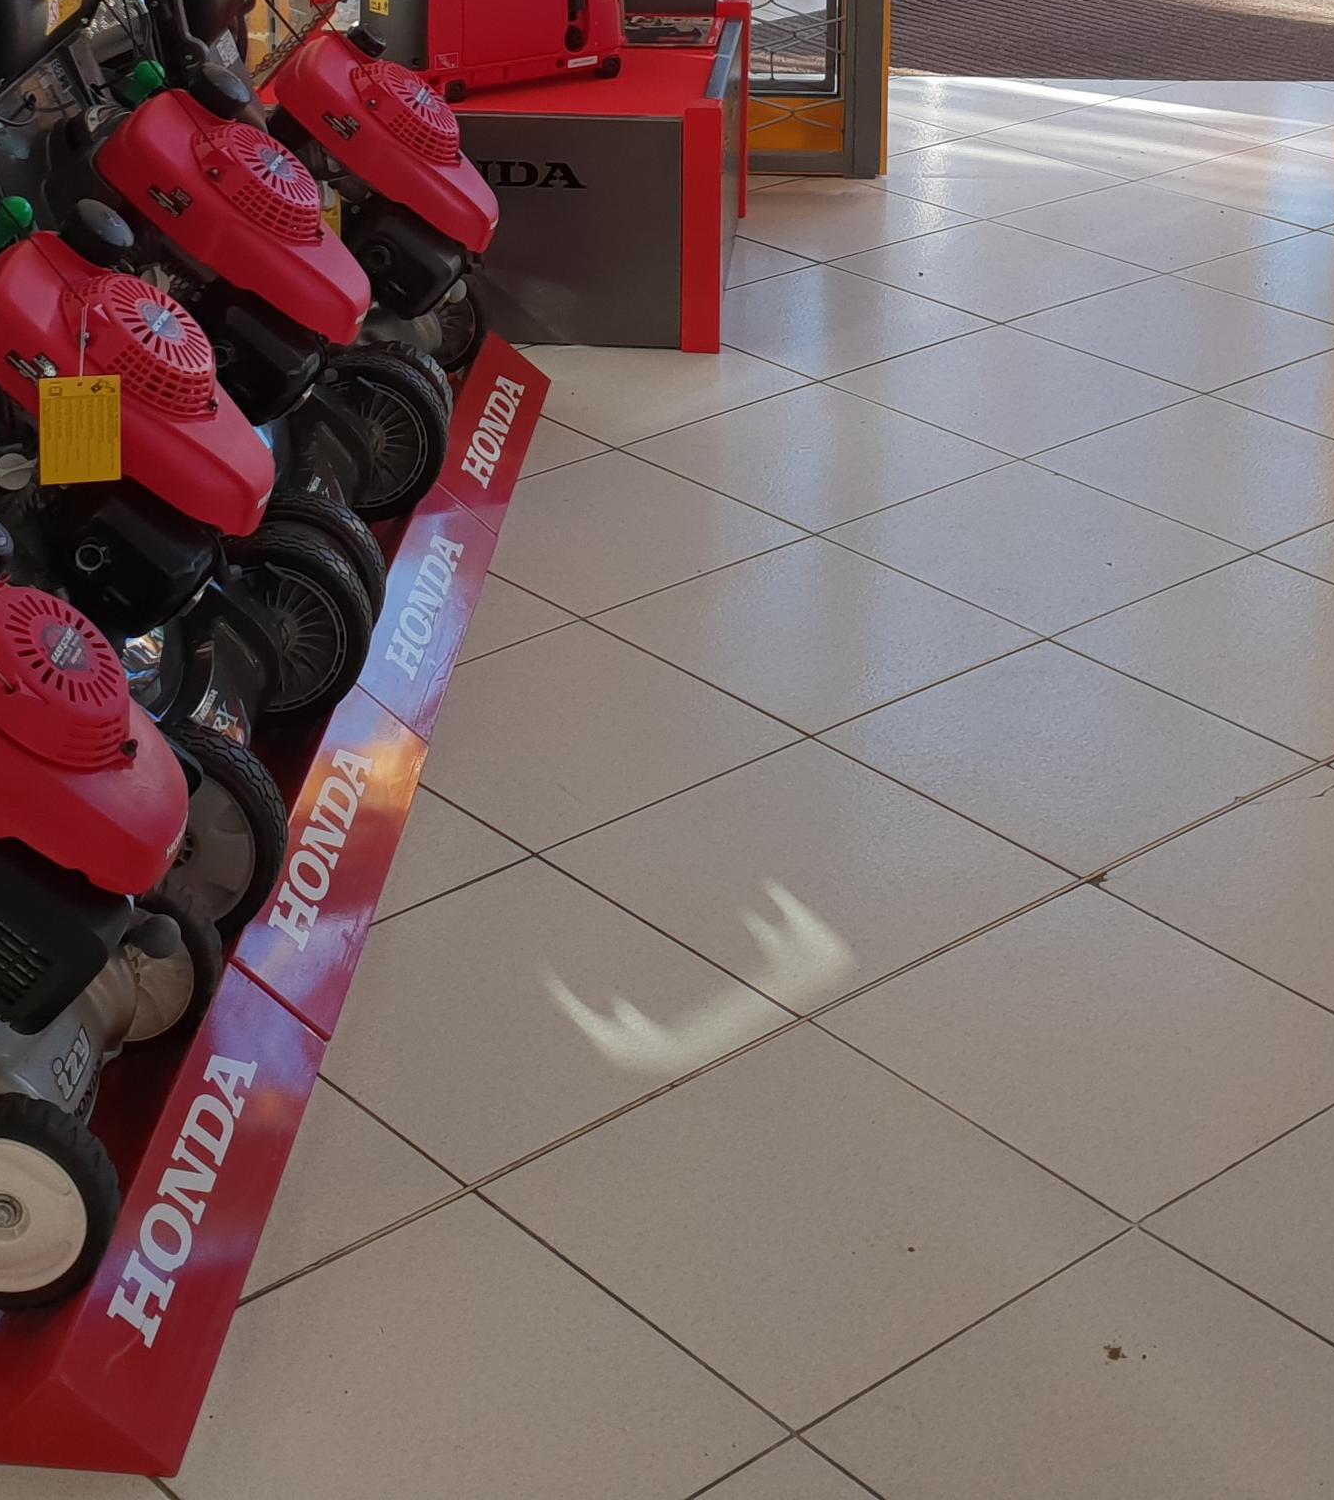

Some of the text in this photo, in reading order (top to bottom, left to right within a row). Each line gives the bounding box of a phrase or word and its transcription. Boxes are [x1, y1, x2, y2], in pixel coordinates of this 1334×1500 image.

[460, 374, 526, 490] HONDA
[384, 532, 464, 681] HONDA
[267, 747, 373, 953] HONDA
[107, 1052, 259, 1348] HONDA
